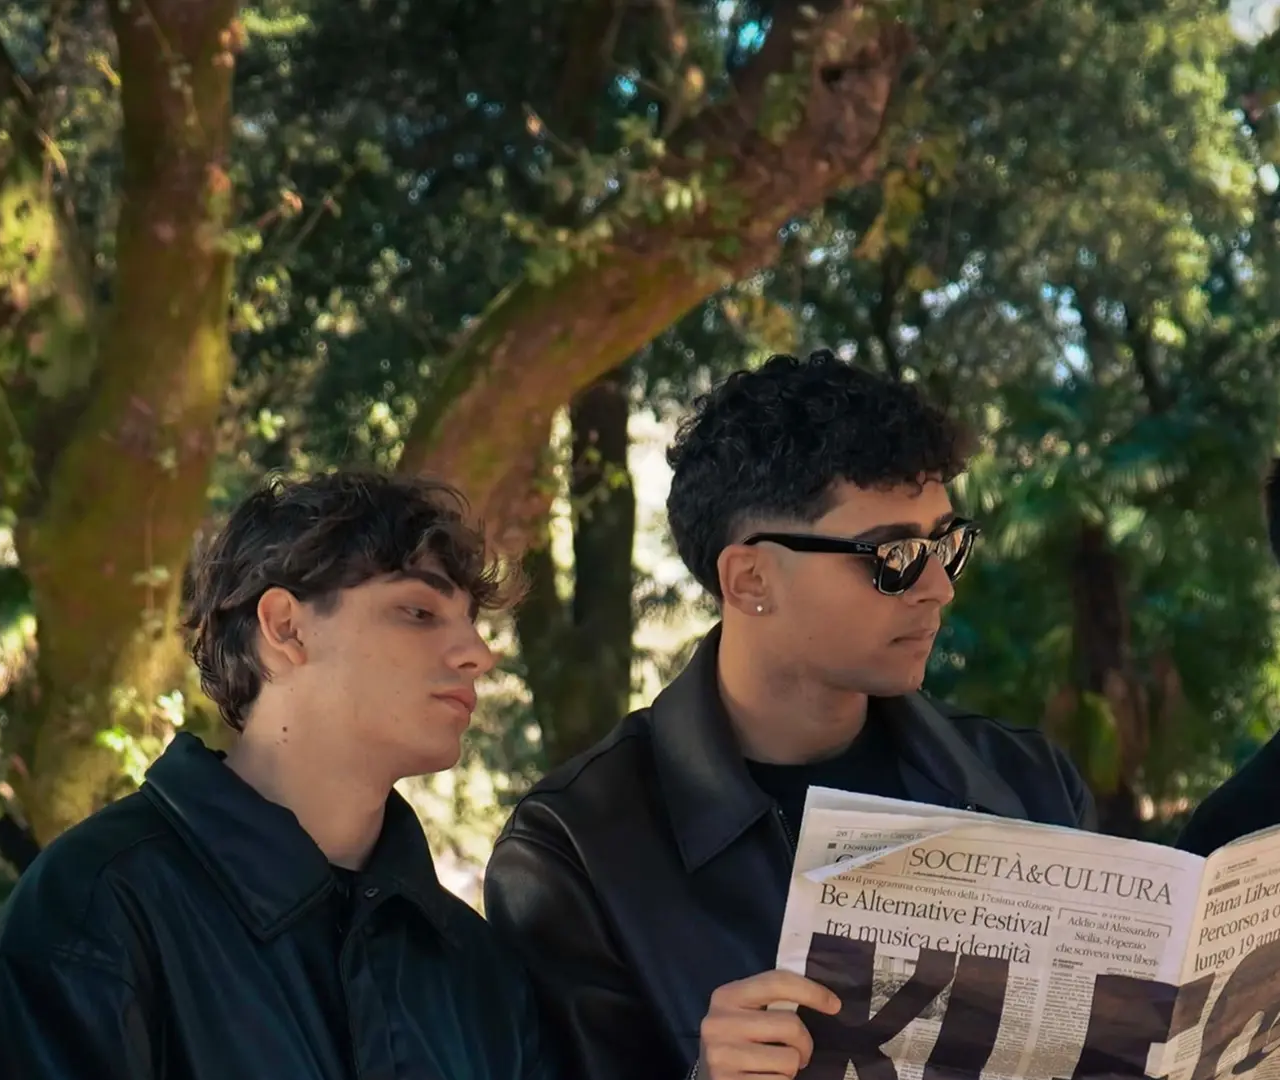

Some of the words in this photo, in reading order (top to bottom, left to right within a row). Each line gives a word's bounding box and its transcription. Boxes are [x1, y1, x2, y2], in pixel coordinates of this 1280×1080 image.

[863, 877, 914, 891] programma
[915, 882, 956, 899] completo
[1017, 898, 1055, 913] edizione
[908, 847, 1173, 906] SOCIETÀ&CULTURA
[820, 882, 848, 908] Be
[851, 888, 968, 925] Alternative
[970, 907, 1051, 937] Festival
[1203, 893, 1241, 921] Piana
[825, 916, 852, 940] tra
[858, 924, 932, 952] musica
[935, 934, 950, 952] e
[955, 934, 1032, 965] identità
[1068, 916, 1095, 928] Addio
[1097, 921, 1109, 930] ad
[1110, 923, 1160, 938] Alessandro
[1199, 912, 1258, 946] Percorso
[1261, 907, 1269, 923] a
[1056, 943, 1073, 954] che
[1073, 947, 1109, 960] scriveva
[1194, 948, 1235, 973] lungo
[1239, 936, 1256, 956] 19
